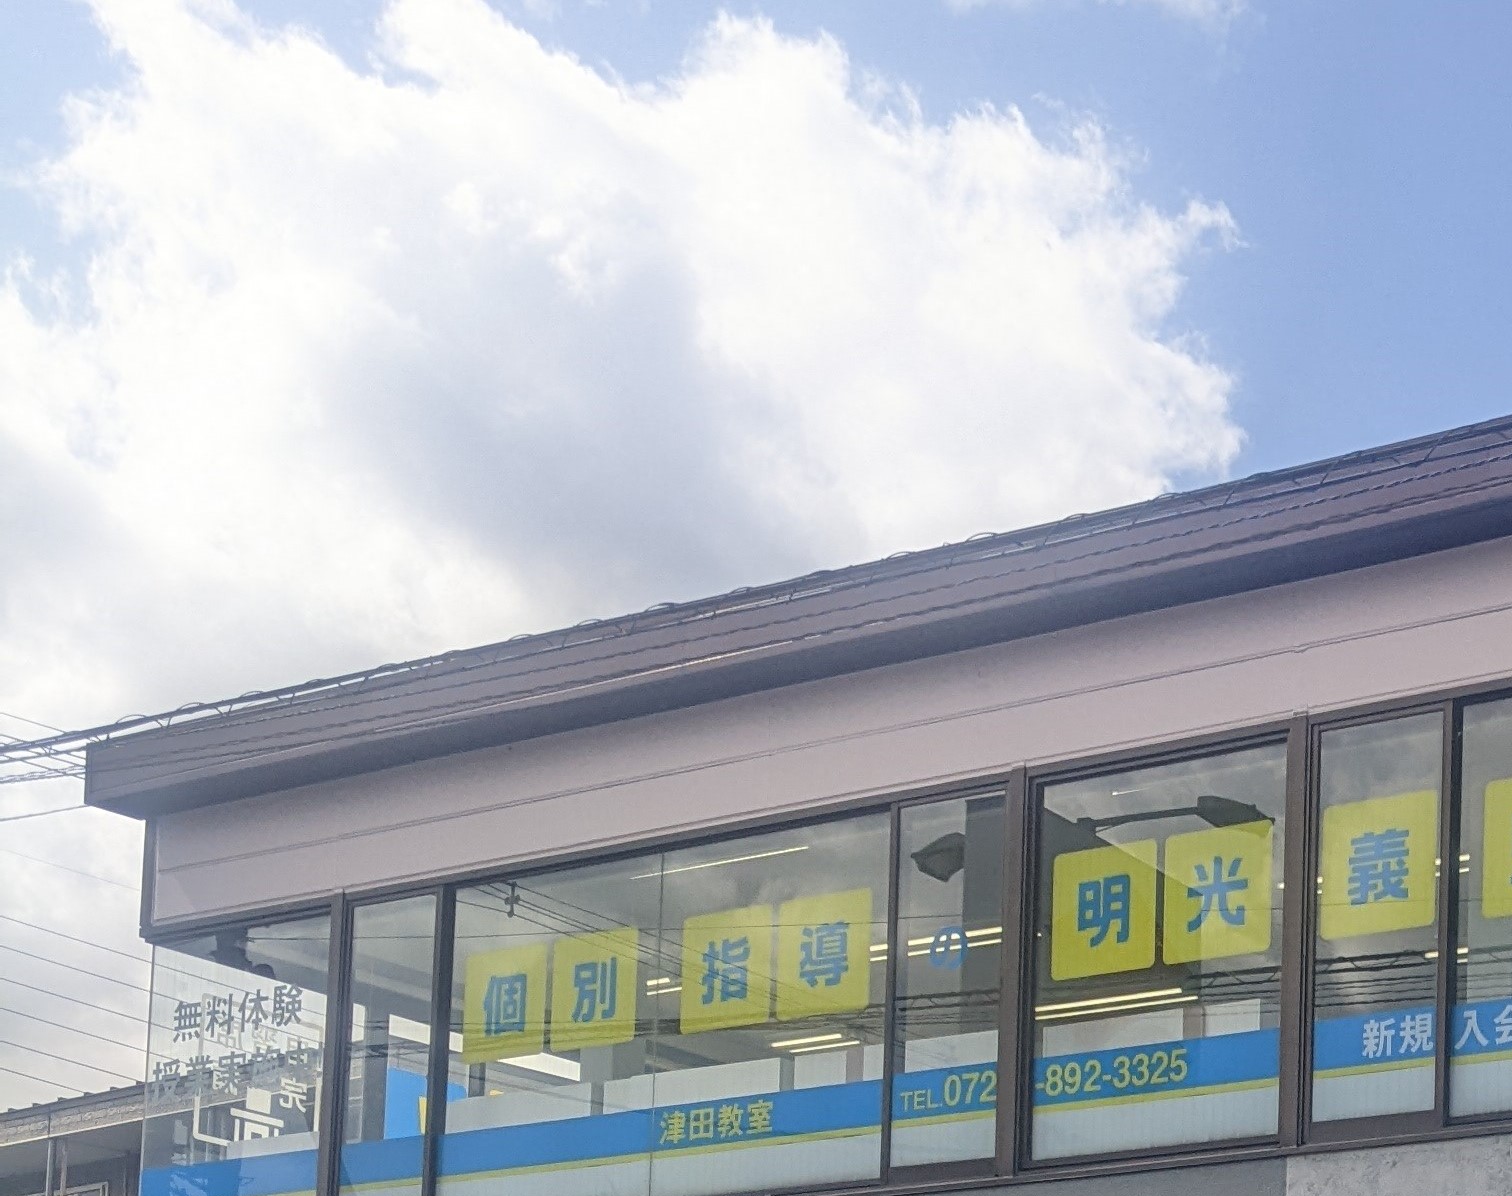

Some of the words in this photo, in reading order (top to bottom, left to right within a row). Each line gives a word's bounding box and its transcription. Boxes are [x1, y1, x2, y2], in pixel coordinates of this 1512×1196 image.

[173, 983, 303, 1044] 無料体験
[658, 1099, 774, 1146] 津田教室
